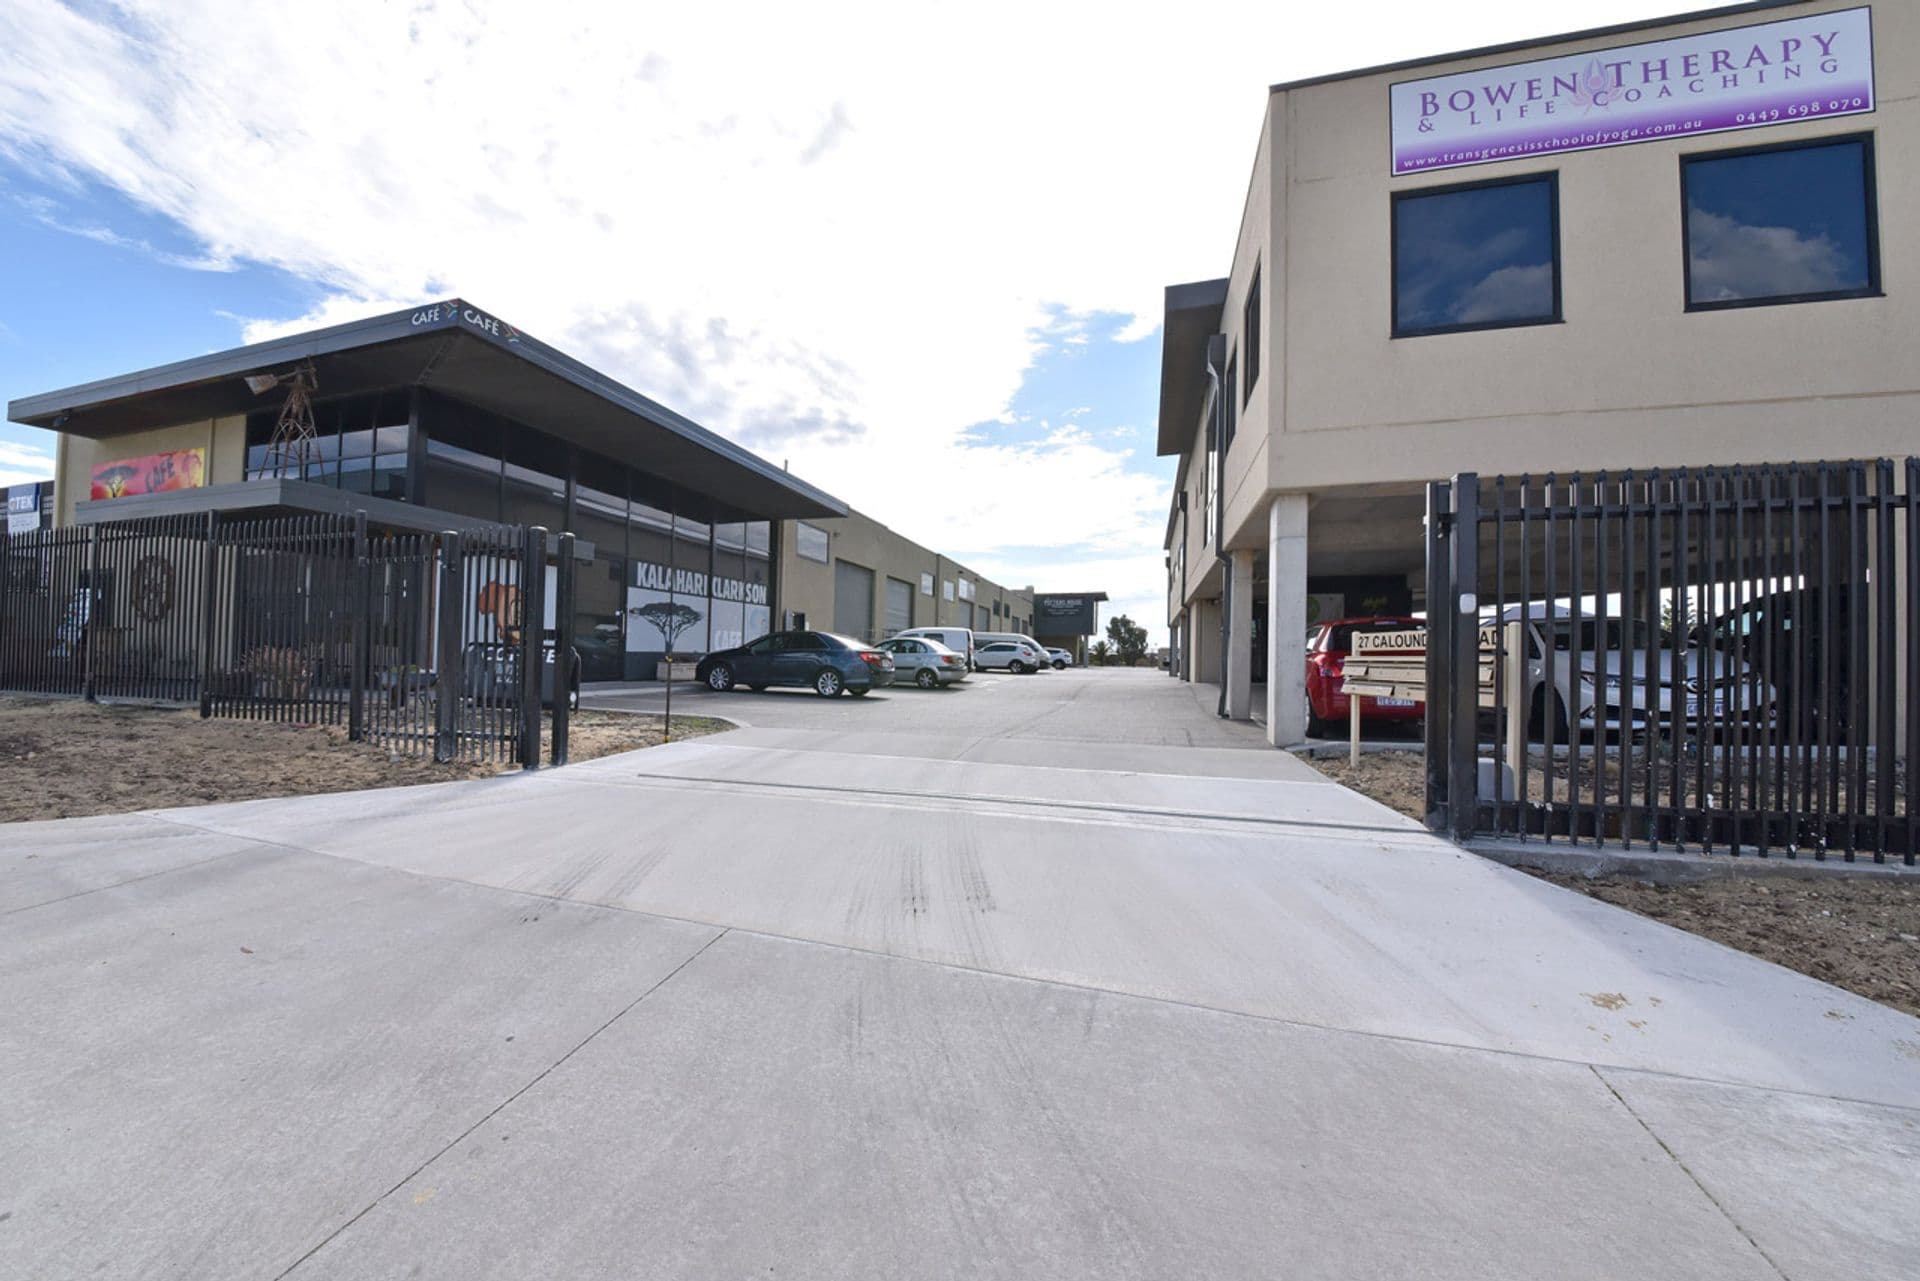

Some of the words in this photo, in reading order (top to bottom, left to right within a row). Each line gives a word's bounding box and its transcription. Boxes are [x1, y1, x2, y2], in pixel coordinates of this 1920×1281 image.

[1418, 118, 1435, 133] &
[1470, 101, 1556, 125] LIFE
[1593, 58, 1838, 107] COACHING
[1420, 72, 1578, 117] BOWEN
[1605, 31, 1841, 88] THERAPY
[1403, 120, 1702, 168] www.transgenesisschoolofyoga.com.au
[1736, 109, 1779, 123] 0449
[1788, 101, 1820, 116] 698
[1829, 97, 1861, 110] 070
[637, 561, 708, 596] KALAHARI
[1358, 636, 1369, 648] 27
[1372, 633, 1426, 648] CALOUND
